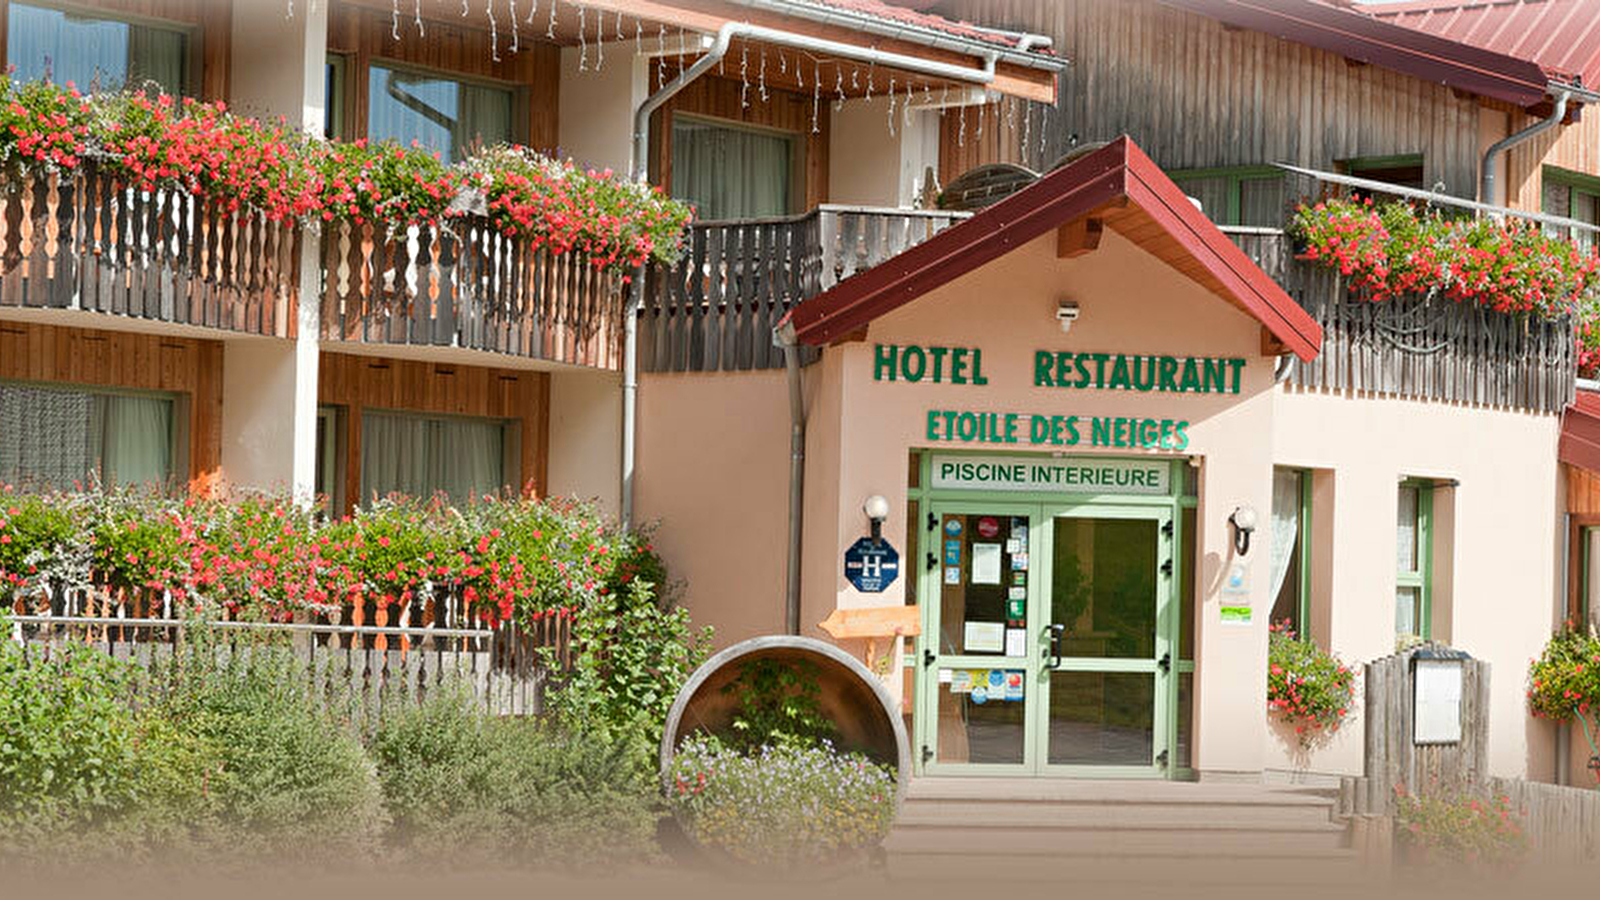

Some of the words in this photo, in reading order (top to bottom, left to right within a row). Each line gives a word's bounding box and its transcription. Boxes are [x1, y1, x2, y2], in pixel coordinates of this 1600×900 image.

[873, 343, 988, 386] HOTEL
[1034, 350, 1247, 395] RESTAURANT
[927, 410, 1018, 444] ETOILE
[1030, 414, 1080, 446] DES
[1092, 417, 1190, 451] NEIGES
[940, 463, 1026, 483] PISCINE
[1031, 465, 1160, 487] INTERIEURE
[862, 555, 881, 577] H
